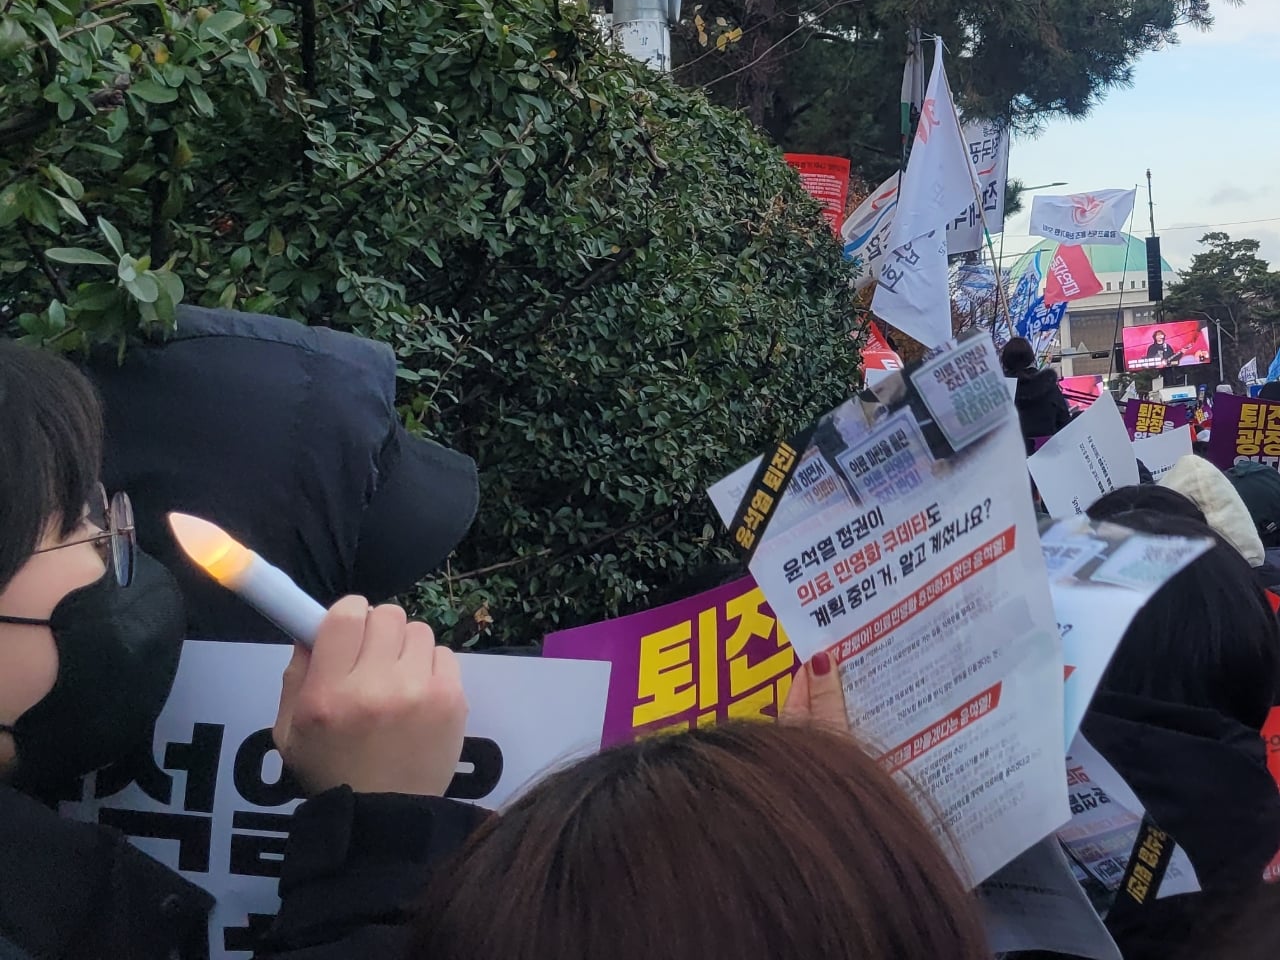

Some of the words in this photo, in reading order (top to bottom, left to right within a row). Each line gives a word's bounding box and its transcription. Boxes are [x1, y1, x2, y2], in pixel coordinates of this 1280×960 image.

[1138, 403, 1166, 419] 퇴진
[735, 495, 777, 548] 윤석열
[763, 442, 796, 493] 퇴진!
[849, 456, 868, 476] 의료
[783, 538, 837, 583] 윤석열
[837, 504, 884, 550] 정권이
[797, 571, 833, 607] 의료
[833, 546, 881, 586] 민영화
[882, 503, 942, 555] 쿠데타도
[809, 597, 847, 628] 계획
[846, 576, 876, 610] 중인
[876, 567, 899, 589] 거,
[898, 546, 927, 578] 알고
[930, 497, 992, 558] 계셨나요?
[632, 585, 797, 728] 퇴진
